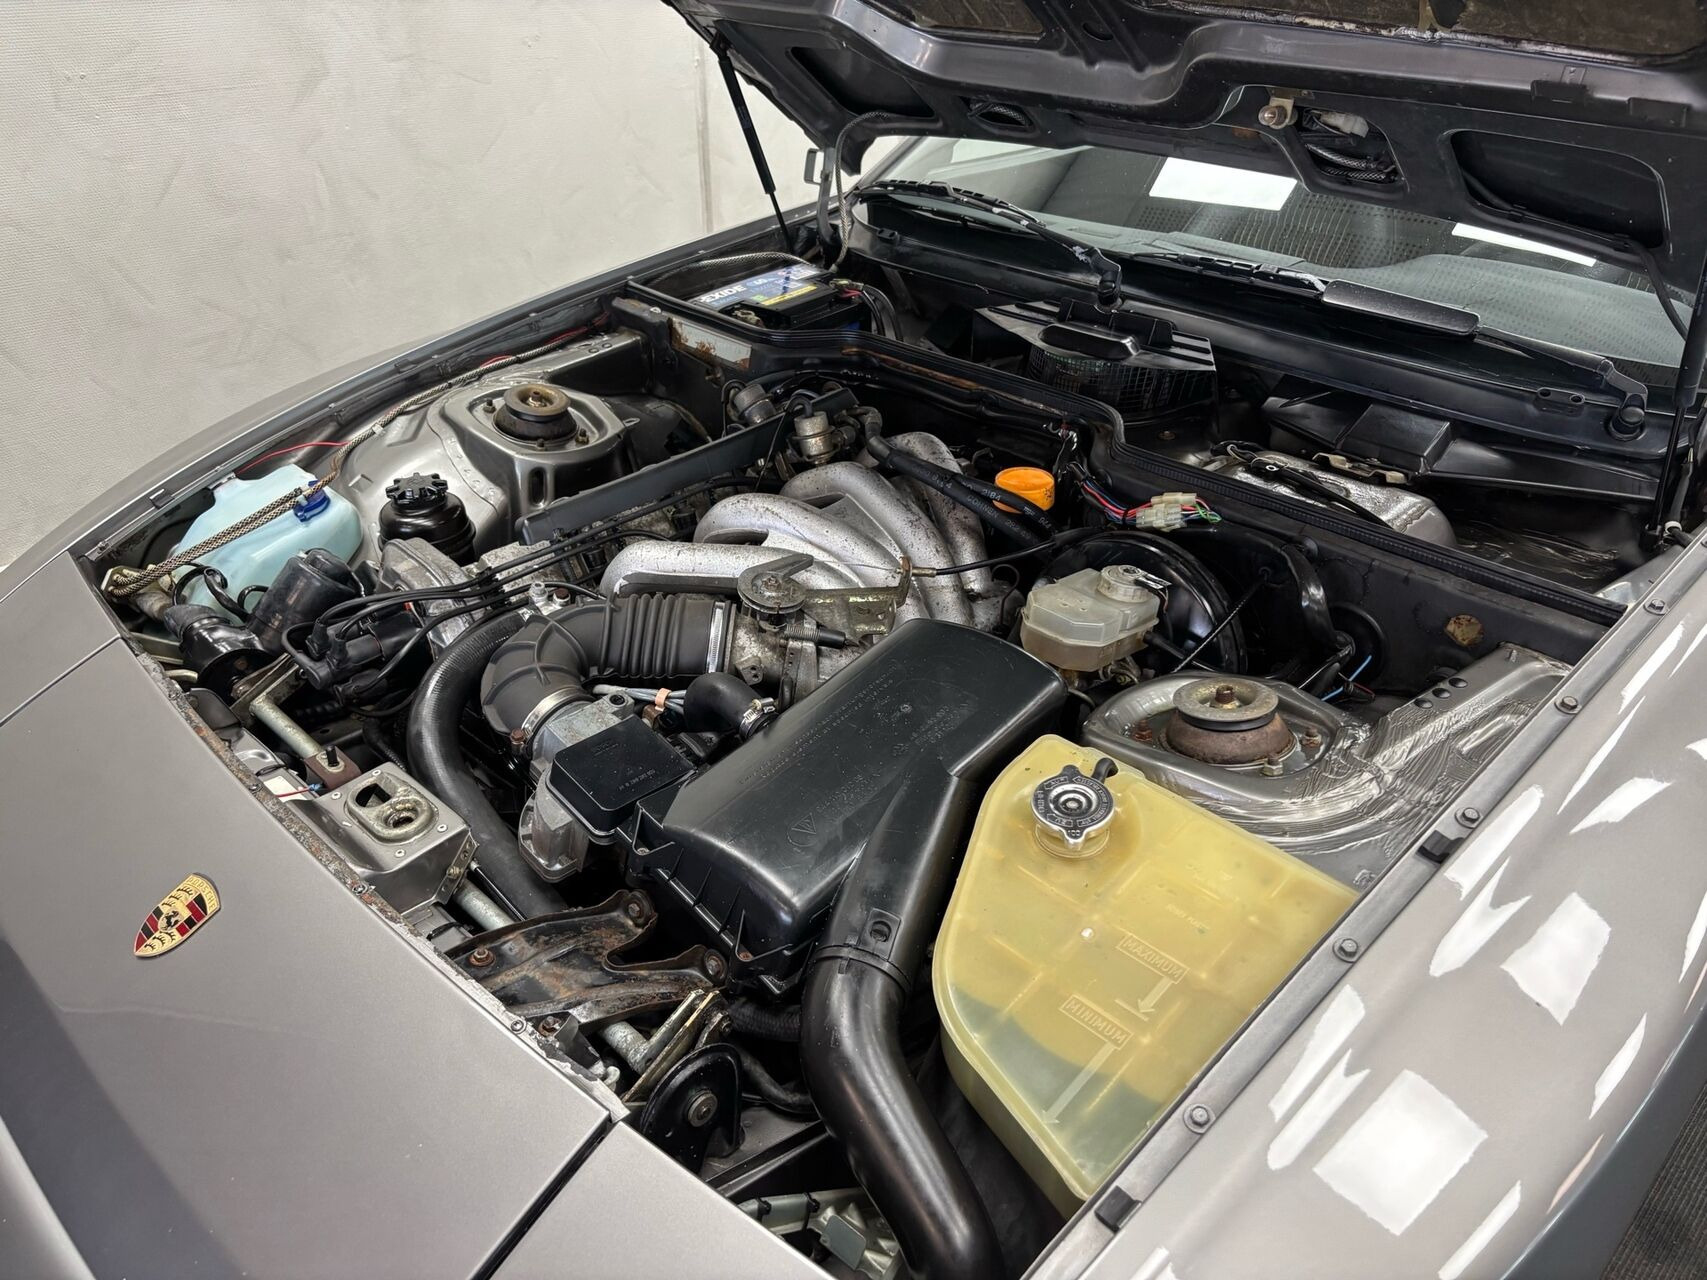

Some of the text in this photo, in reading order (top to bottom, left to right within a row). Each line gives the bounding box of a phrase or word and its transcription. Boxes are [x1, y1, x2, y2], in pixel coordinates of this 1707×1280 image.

[701, 284, 747, 303] EXIDE
[187, 876, 217, 911] PORSCHE
[1122, 939, 1185, 977] MAXIMUM
[1065, 1000, 1128, 1045] MINIMUM
